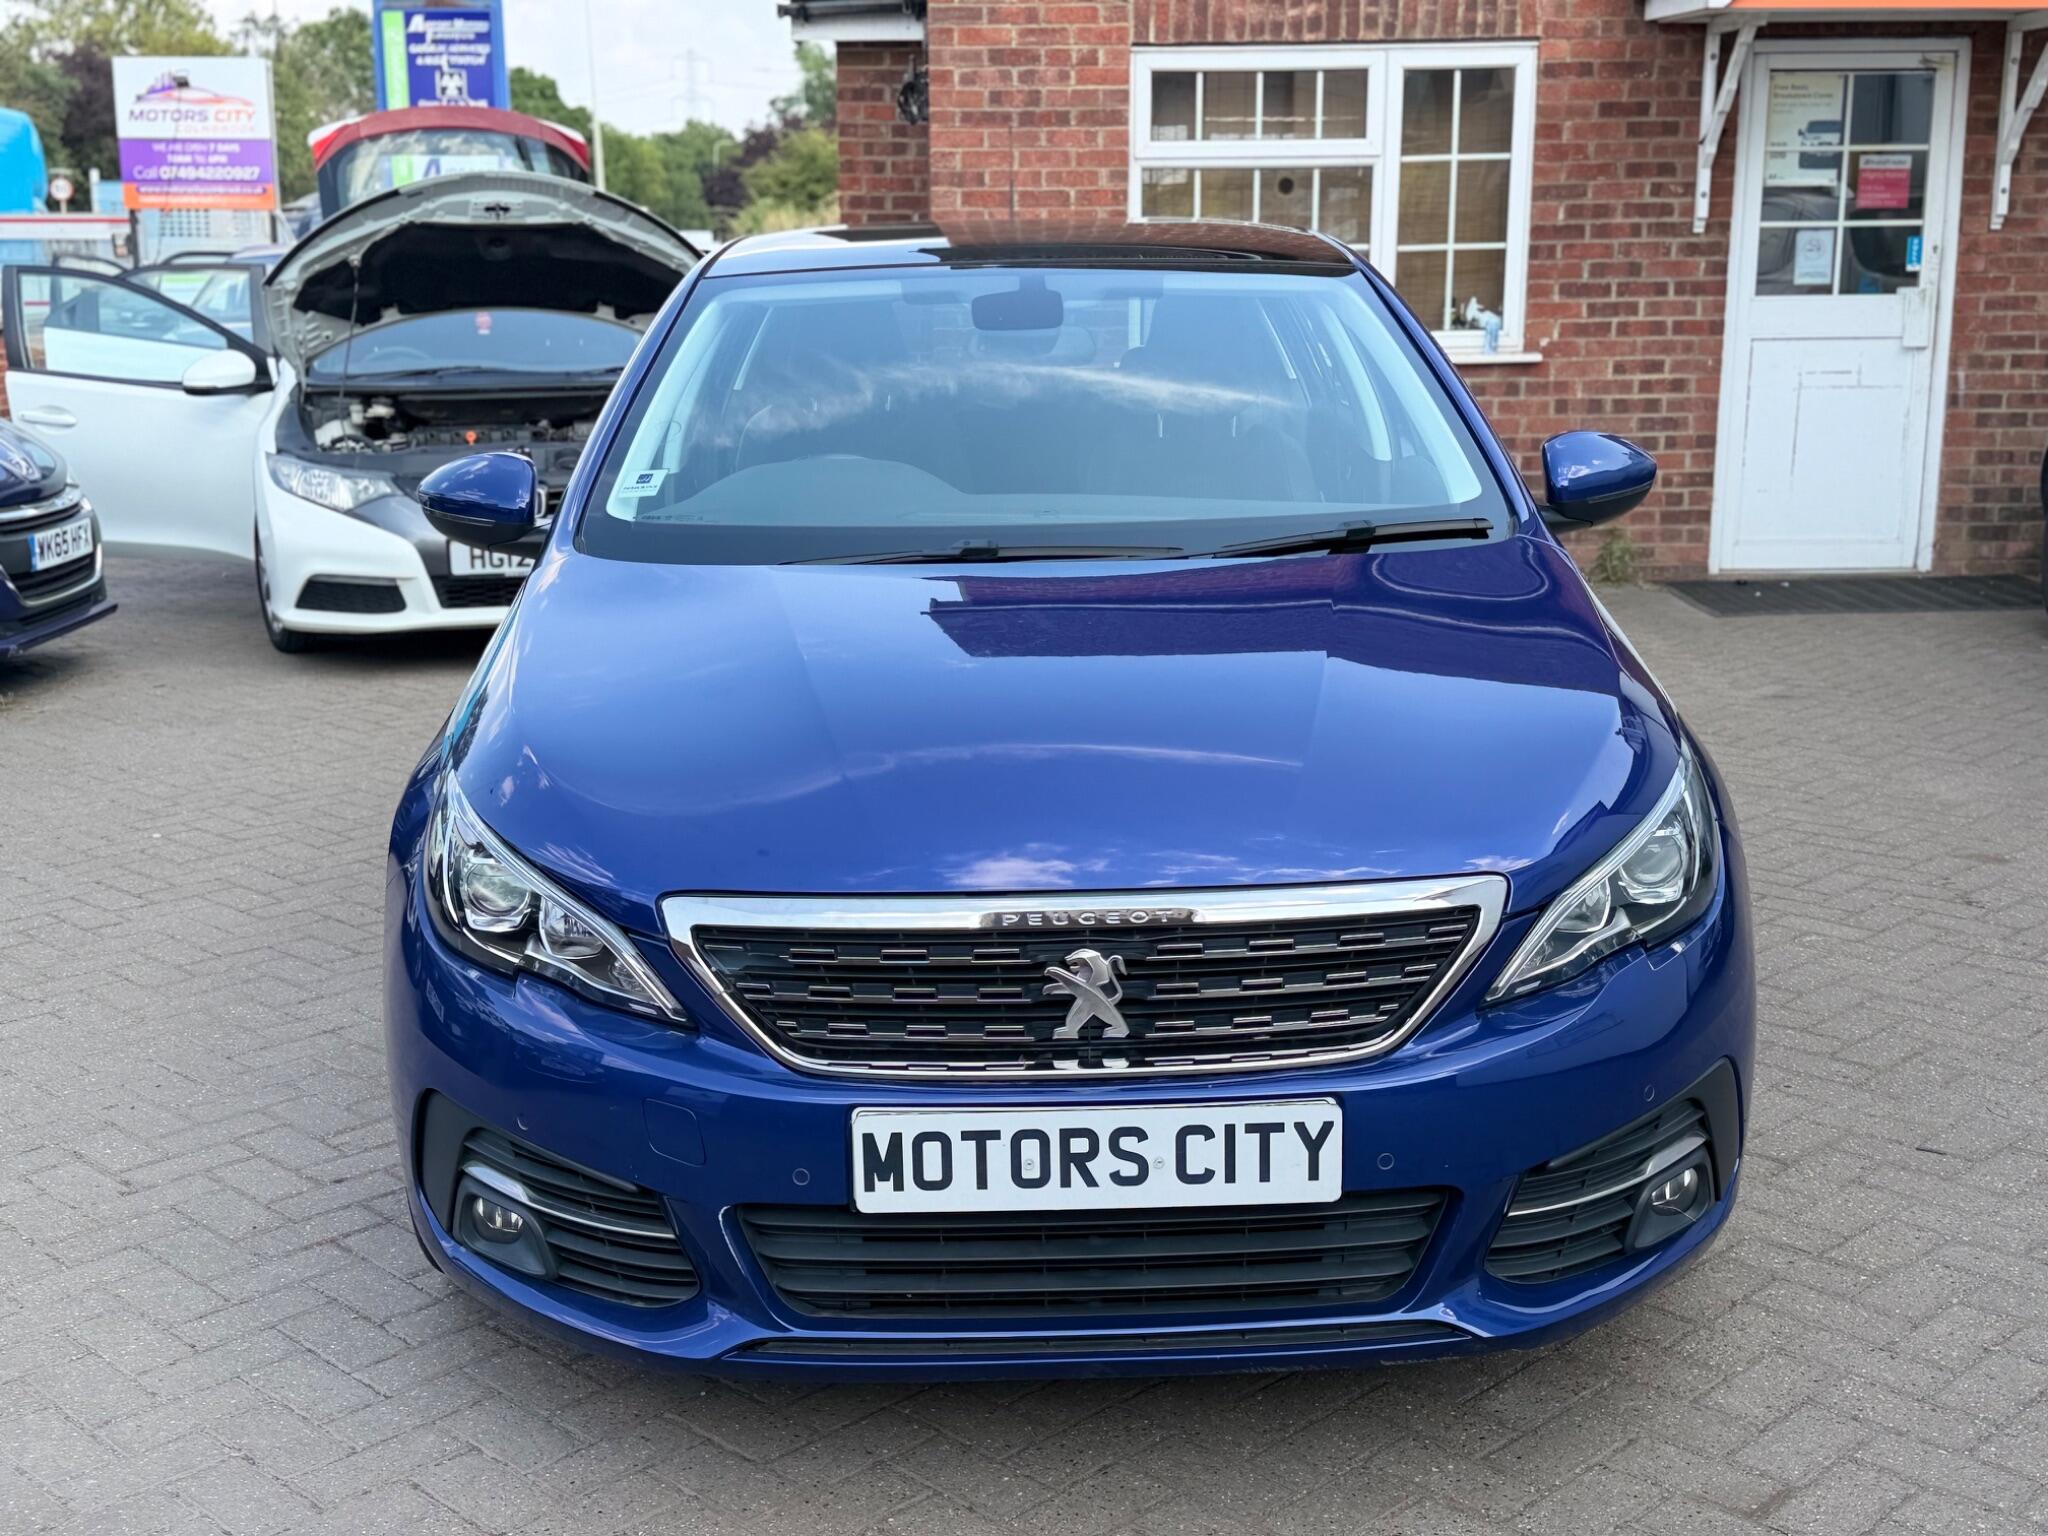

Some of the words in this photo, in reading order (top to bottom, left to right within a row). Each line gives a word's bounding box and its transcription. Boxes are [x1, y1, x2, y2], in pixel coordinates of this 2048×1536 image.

[128, 109, 209, 123] MOTORS
[213, 109, 257, 123] CITY
[132, 166, 157, 180] Call
[37, 530, 69, 562] WK65
[70, 522, 91, 553] HFX
[1002, 909, 1174, 927] PEUGEOT
[861, 1125, 1150, 1193] MOTORS
[1174, 1120, 1335, 1186] CITY
